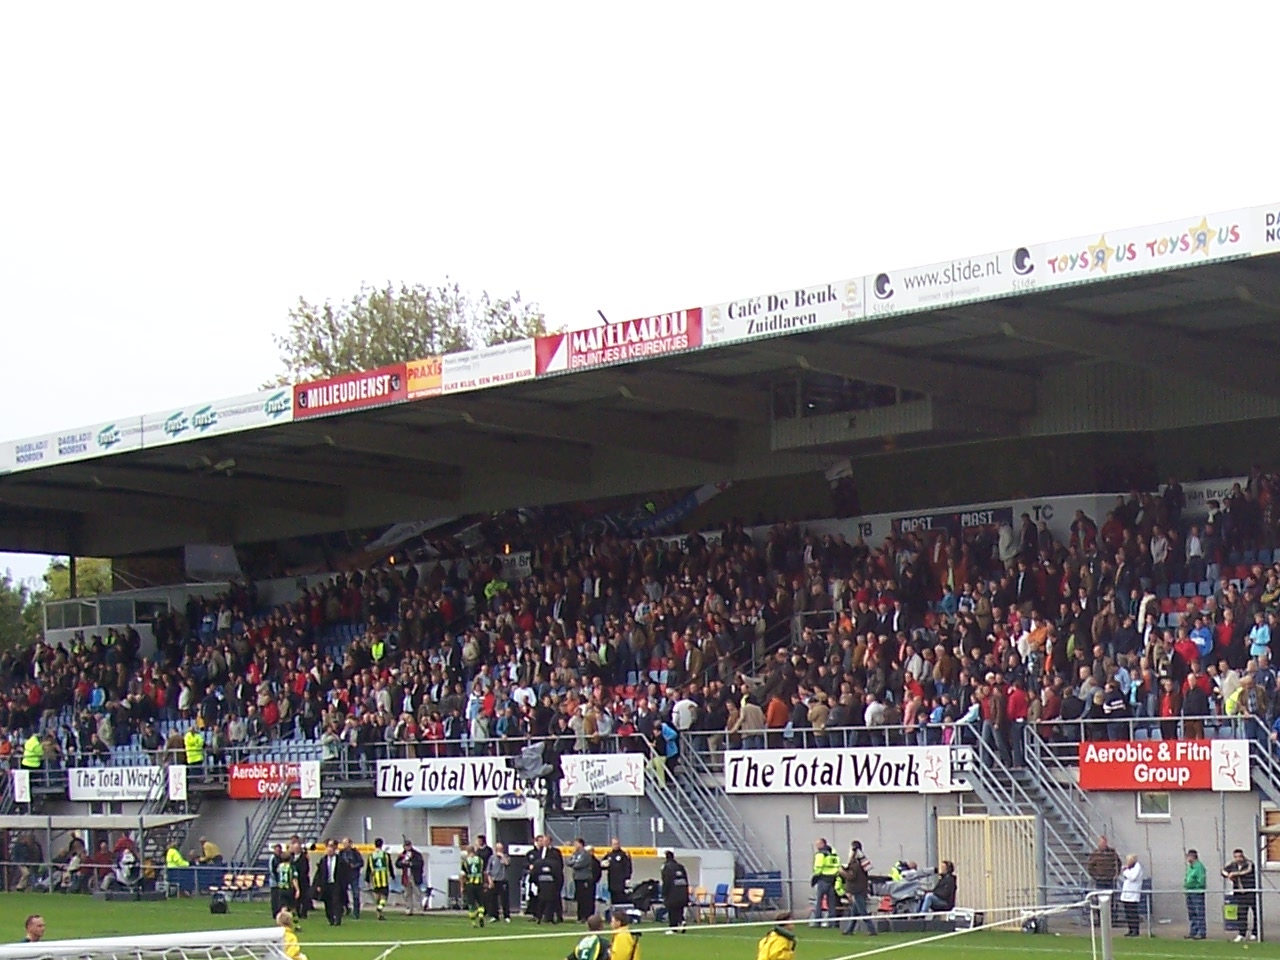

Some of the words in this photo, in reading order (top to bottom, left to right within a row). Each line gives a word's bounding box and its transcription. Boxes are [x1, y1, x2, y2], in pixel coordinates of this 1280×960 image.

[1145, 233, 1190, 258] TOYS
[1217, 224, 1241, 245] US
[1047, 251, 1090, 274] TOYS
[1115, 243, 1137, 263] US
[727, 296, 762, 321] Café
[767, 294, 789, 313] De
[794, 284, 837, 308] Beuk
[572, 310, 688, 353] MAKELAARDIJ
[746, 312, 817, 335] Zuidlaren
[571, 347, 620, 369] BRUINTJES
[620, 347, 627, 359] &
[628, 334, 688, 357] KEURENTJES
[307, 374, 390, 410] MILIEUDIENST
[1083, 742, 1154, 763] Aerobic
[1157, 742, 1172, 762] &
[1175, 741, 1212, 762] Fitn
[76, 769, 97, 788] The
[98, 768, 124, 787] Total
[232, 765, 269, 779] Aerobic
[380, 764, 415, 792] The
[418, 763, 466, 791] Total
[728, 756, 775, 788] The
[781, 753, 843, 787] Total
[1133, 763, 1191, 786] Group
